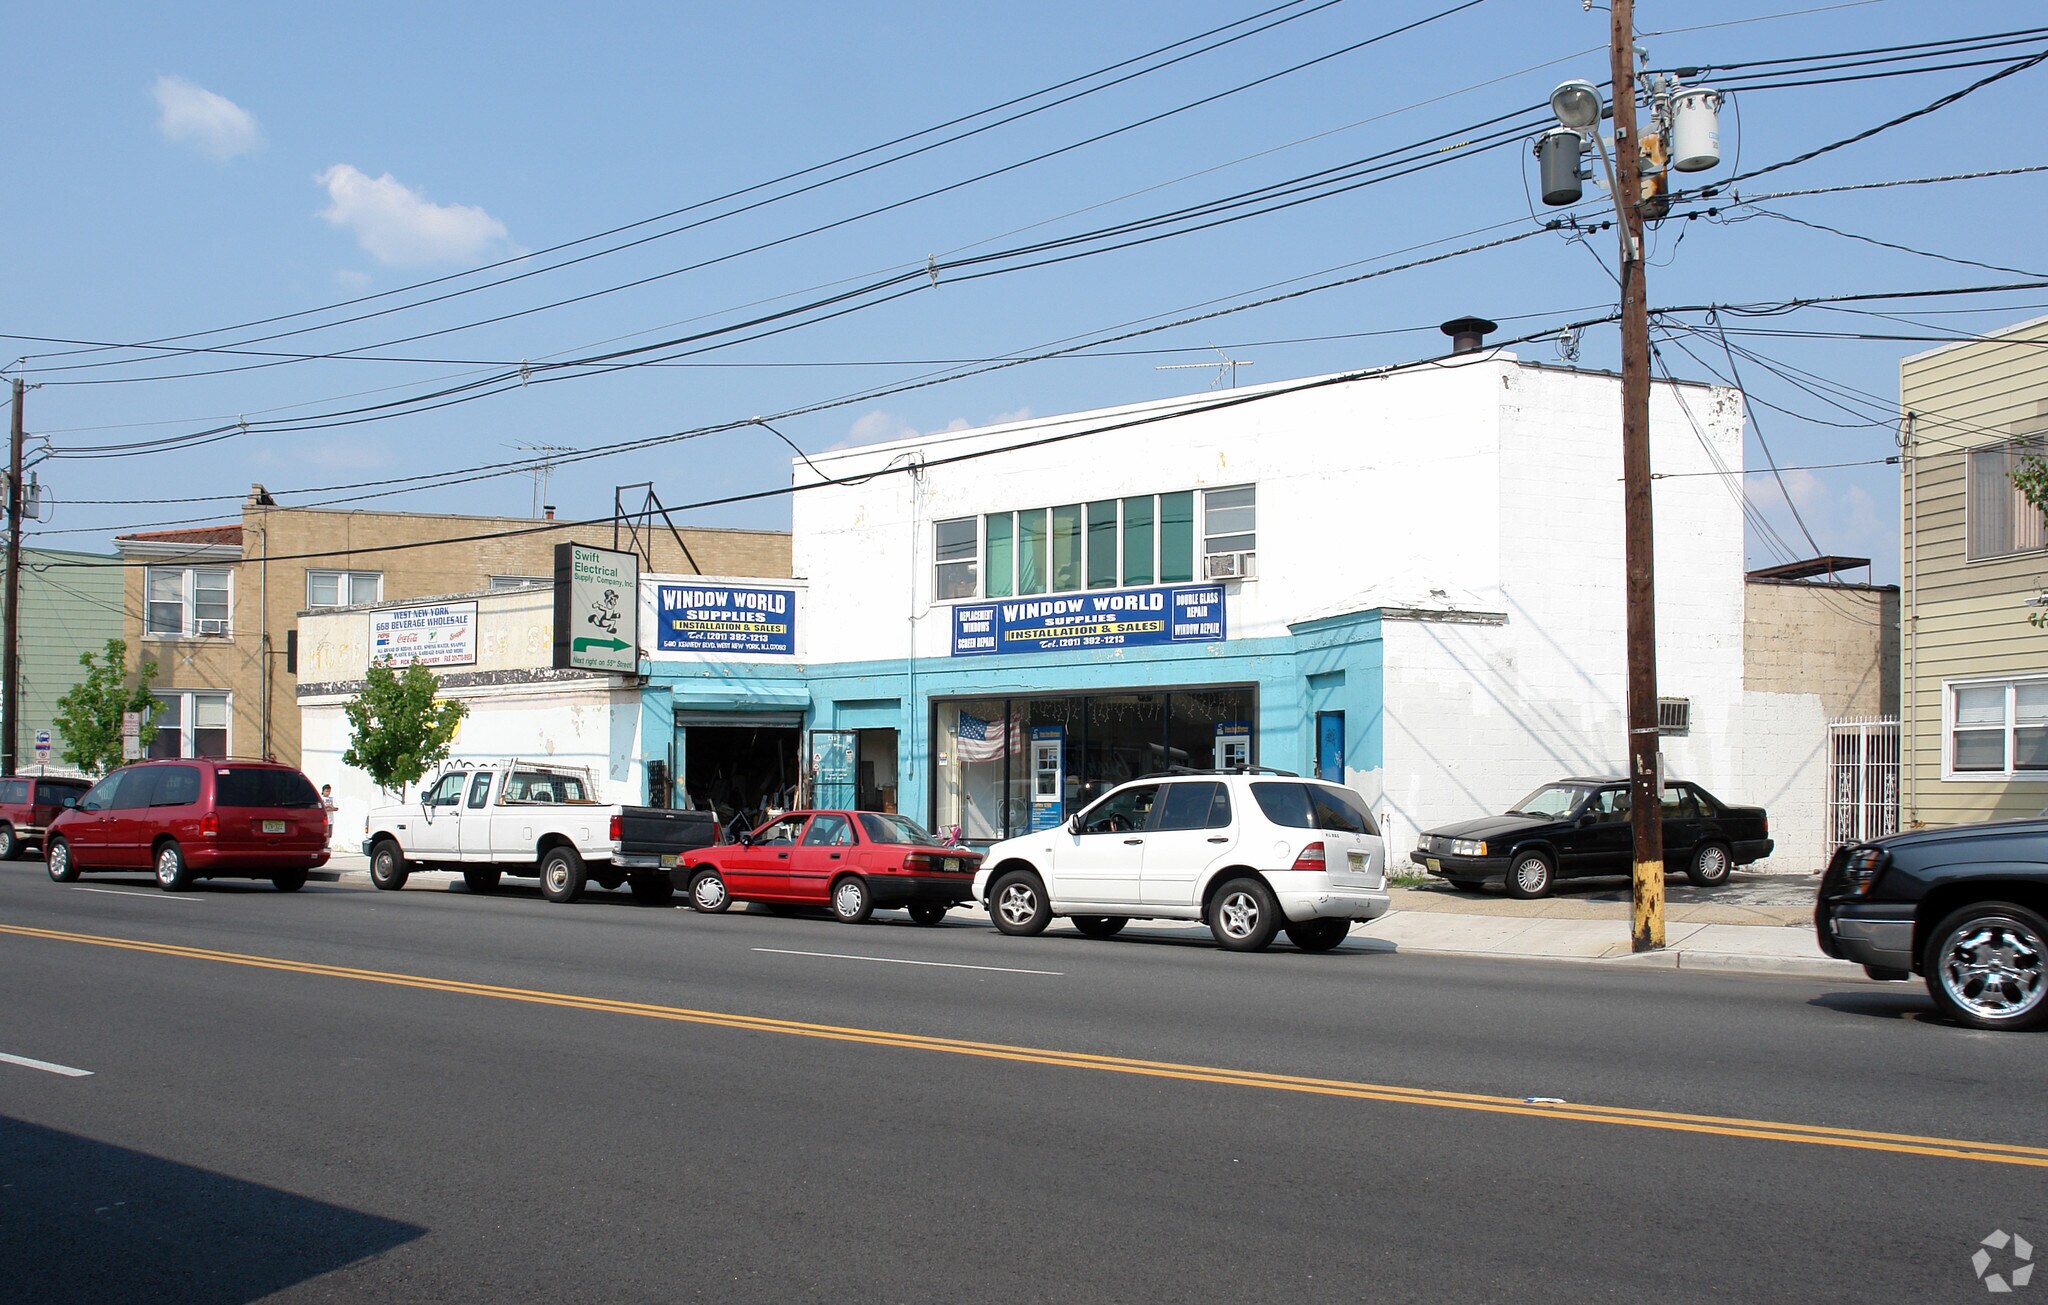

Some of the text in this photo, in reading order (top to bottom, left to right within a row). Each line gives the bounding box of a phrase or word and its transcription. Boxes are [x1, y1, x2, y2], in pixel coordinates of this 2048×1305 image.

[575, 550, 600, 563] Swift
[575, 562, 618, 577] Electrical
[574, 573, 594, 584] Supply
[662, 590, 786, 614] WINDOW WORLD
[1176, 592, 1218, 606] DOUBLE GLASS
[394, 607, 449, 620] WEST NEW YORK
[1003, 593, 1163, 622] WINDOW WORLD
[1186, 606, 1208, 618] REPAIR
[686, 610, 766, 622] SUPPLIES
[960, 610, 994, 621] REPLACEMENT
[1045, 614, 1116, 626] SUPPLIES
[376, 615, 468, 631] 668 BEVERAGE WHOLESALE
[679, 621, 741, 630] INSTALLATION
[754, 624, 781, 632] SALES
[963, 622, 990, 632] WINDOWS
[1010, 626, 1097, 639] INSTALLATION
[1117, 622, 1158, 632] SALES
[1175, 623, 1220, 636] WINDOW REPAIR
[688, 632, 768, 642] Tel. (201) 392-1213
[958, 636, 994, 650] SCREEN REPAIR
[1040, 636, 1125, 648] Tel. (201) 392-1213
[573, 656, 584, 665] Next
[585, 658, 600, 668] right
